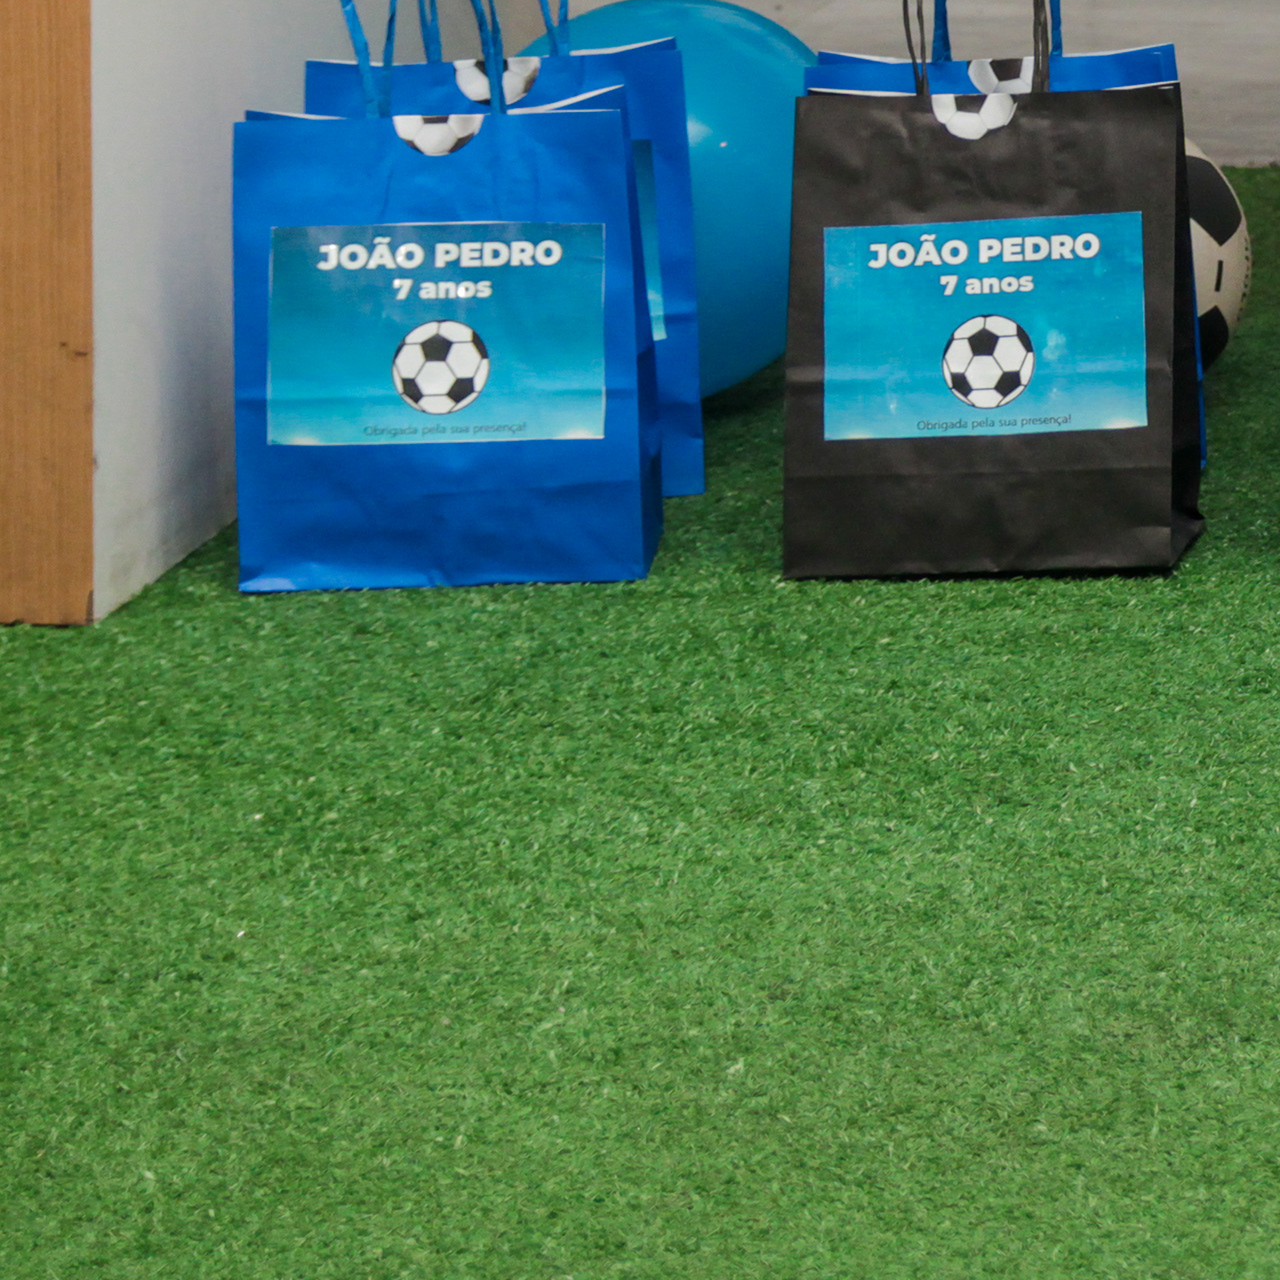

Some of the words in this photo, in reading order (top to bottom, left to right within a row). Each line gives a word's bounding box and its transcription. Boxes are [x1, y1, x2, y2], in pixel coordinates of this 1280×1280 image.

[317, 237, 425, 270] JOÃO
[435, 240, 562, 268] PEDRO
[868, 233, 969, 269] JOÃO
[978, 232, 1100, 263] PEDRO
[392, 279, 413, 299] 7
[419, 280, 493, 299] anos
[940, 275, 958, 296] 7
[965, 275, 1034, 294] anos
[917, 420, 968, 432] Obrigada
[972, 418, 995, 430] pela
[1021, 414, 1072, 427] presença!
